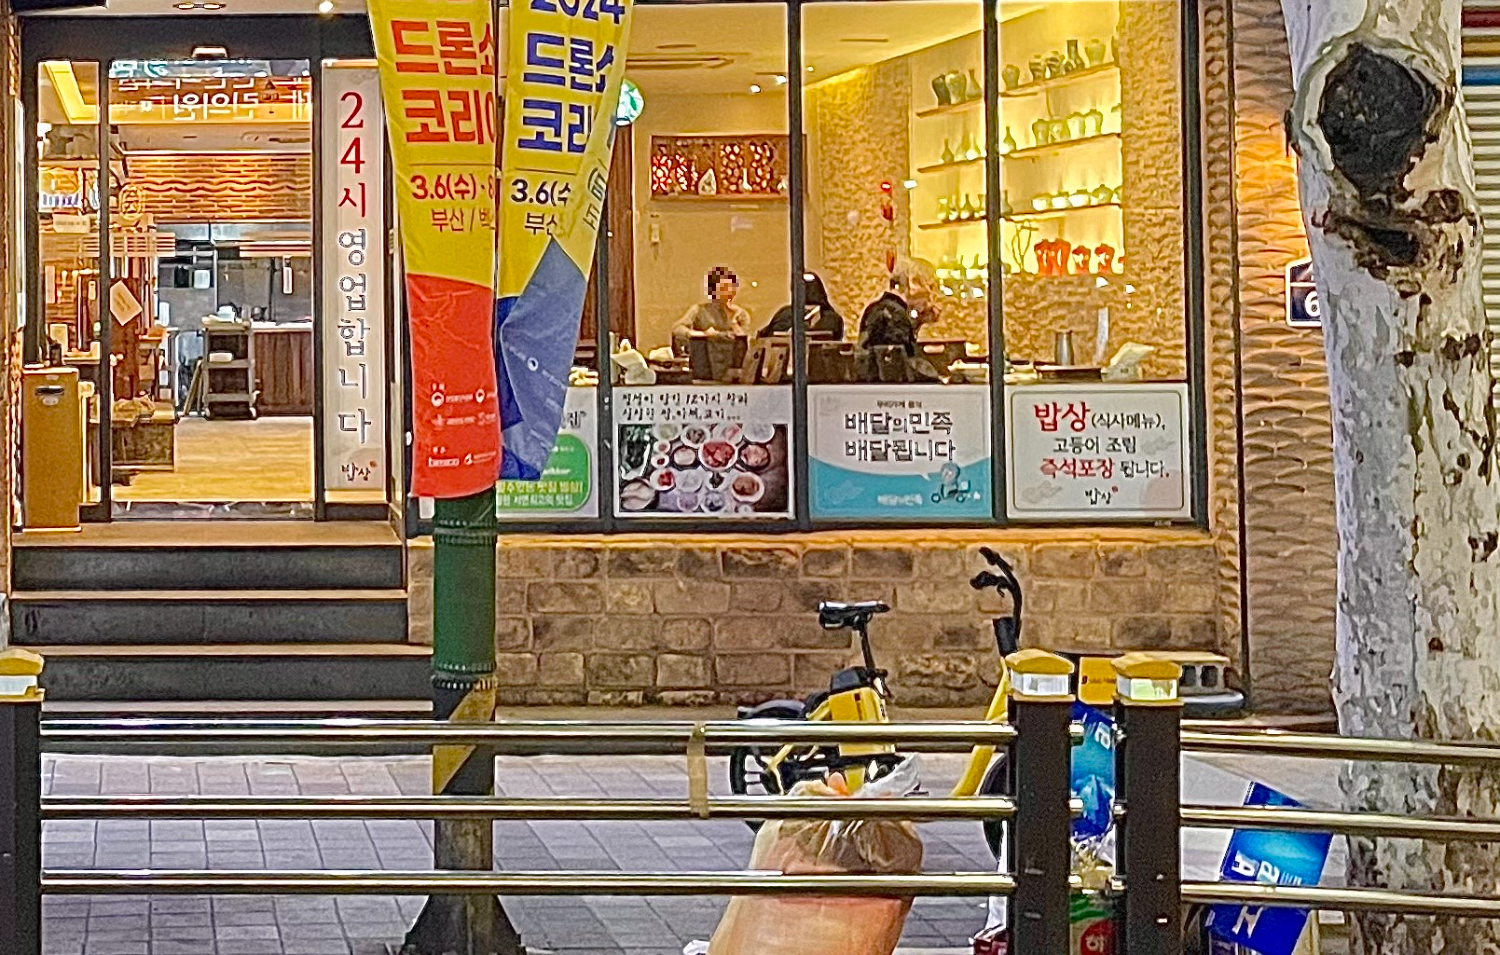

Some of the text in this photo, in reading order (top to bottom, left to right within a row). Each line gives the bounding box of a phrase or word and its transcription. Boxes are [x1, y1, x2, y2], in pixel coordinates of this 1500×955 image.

[844, 412, 953, 434] 배달의민족
[844, 439, 957, 462] 배달됩니다
[1053, 436, 1137, 455] 고등어 조림
[1040, 457, 1170, 480] 즉석포장 됩니다.
